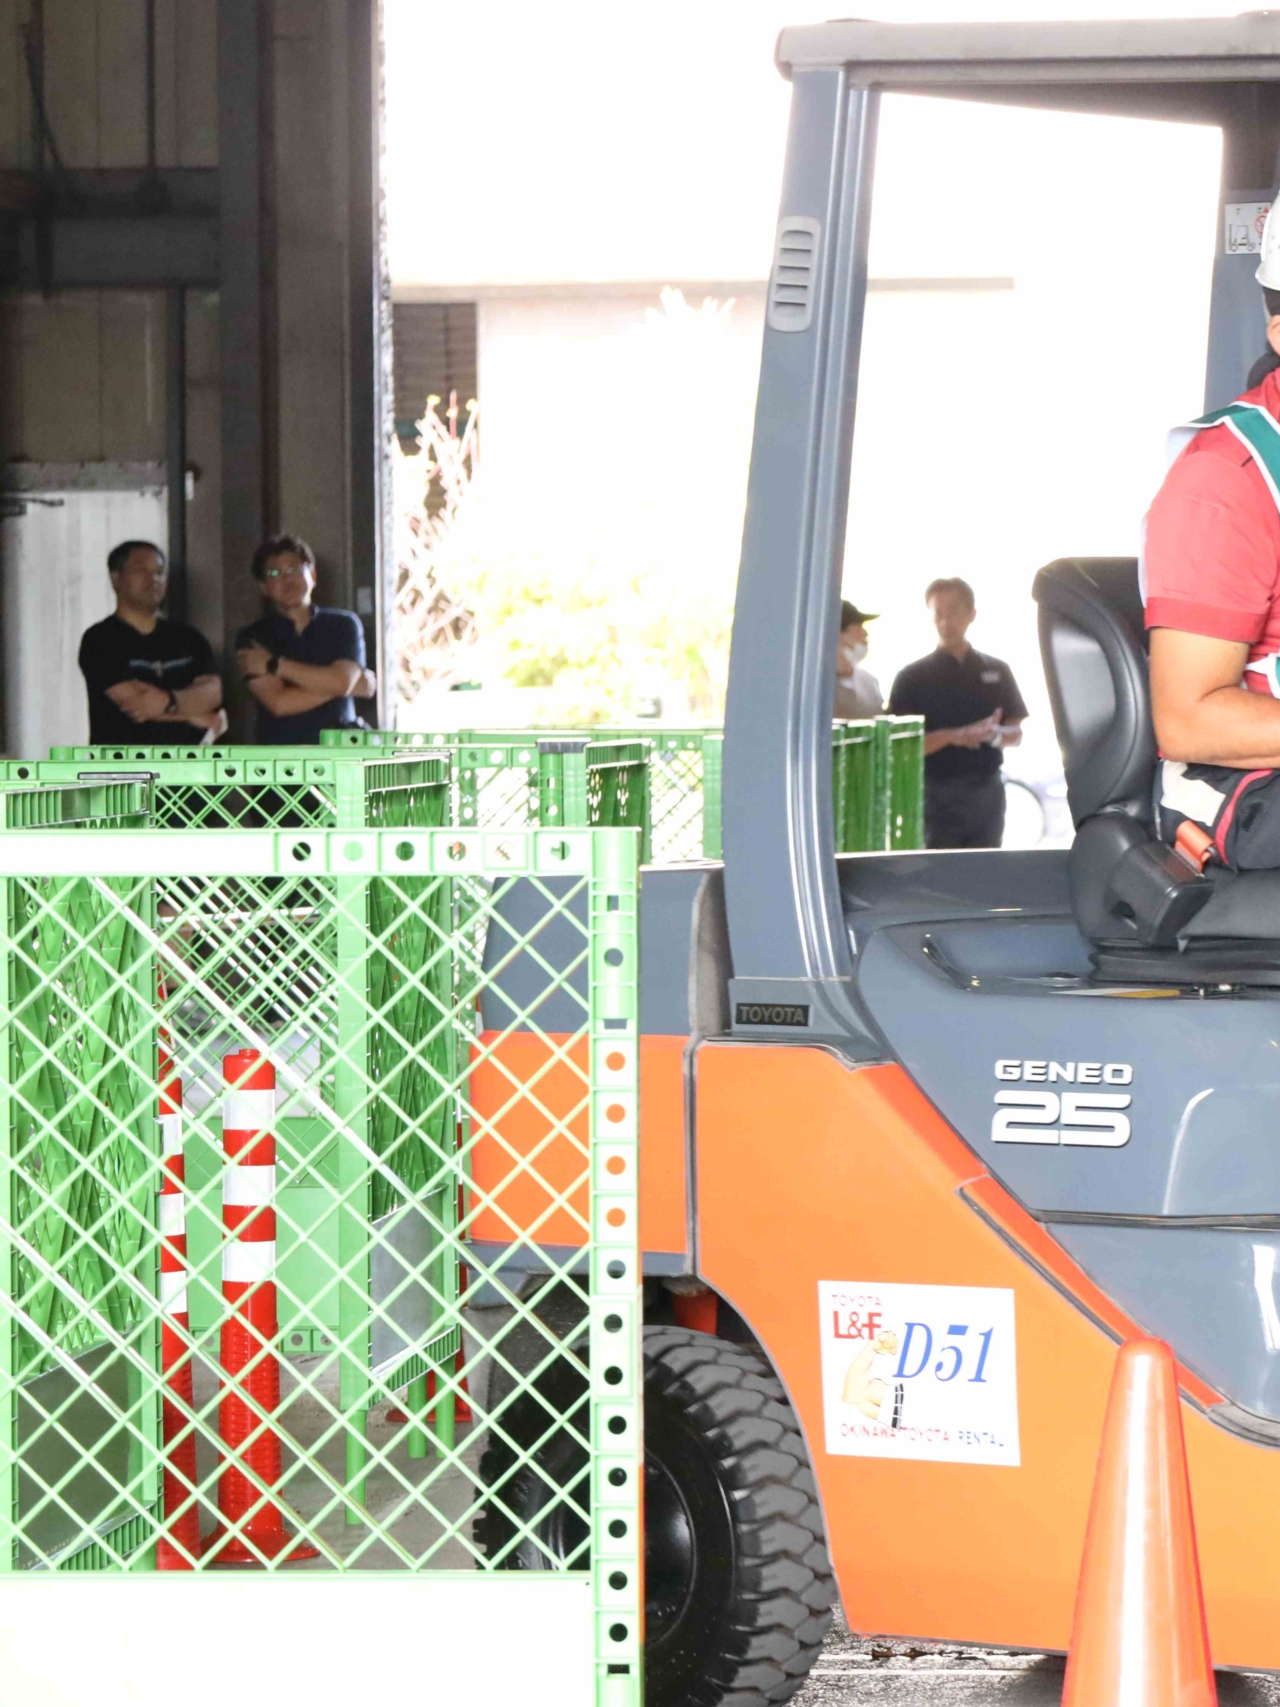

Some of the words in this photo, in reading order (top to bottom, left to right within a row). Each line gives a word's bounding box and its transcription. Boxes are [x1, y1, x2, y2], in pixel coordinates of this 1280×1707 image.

[739, 1005, 806, 1023] TOYOTA
[994, 1059, 1133, 1086] GENEO
[991, 1089, 1132, 1148] 25
[831, 1294, 882, 1308] TOYOTA
[833, 1310, 882, 1341] L&F
[892, 1321, 994, 1383] D51
[841, 1423, 897, 1438] OKINAWA
[900, 1426, 949, 1442] TOYOTA
[958, 1430, 1004, 1447] RENTAL
